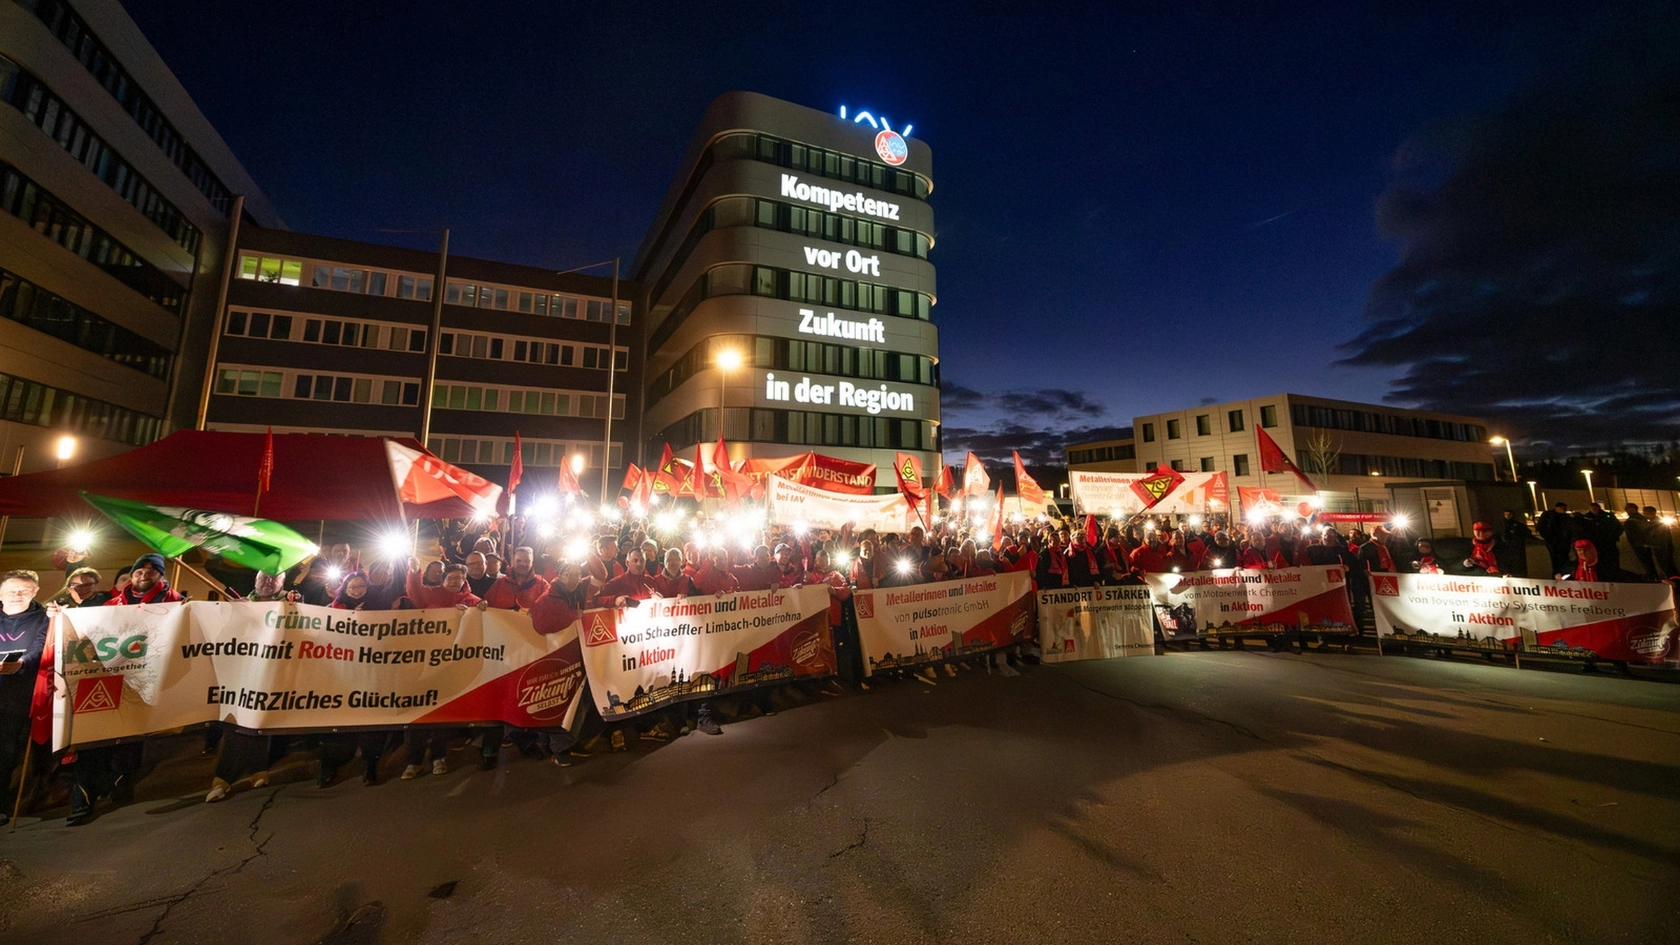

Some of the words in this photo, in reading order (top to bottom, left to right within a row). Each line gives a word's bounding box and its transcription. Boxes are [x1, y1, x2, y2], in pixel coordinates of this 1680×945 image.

[781, 173, 900, 221] Kompetenz
[803, 246, 842, 269] vor
[845, 249, 880, 277] Ort
[798, 308, 885, 343] Zukunft
[766, 372, 790, 401] in
[794, 377, 834, 405] der
[839, 381, 914, 414] Region
[803, 466, 873, 487] WIDERSTAND
[1079, 474, 1131, 483] Metallerinnen
[776, 492, 788, 501] bei
[790, 495, 806, 503] IAV
[1179, 573, 1241, 587] Metallerinnen
[1242, 573, 1262, 584] und
[1264, 573, 1302, 584] Metaller
[886, 587, 948, 606] Metallerinnen
[949, 585, 964, 597] und
[965, 580, 997, 595] Metaller
[1041, 590, 1093, 605] STANDORT
[1096, 590, 1103, 601] D
[1105, 588, 1151, 601] STÄRKEN
[1184, 592, 1201, 600] vom
[1203, 588, 1257, 598] Motorenwerk
[1260, 588, 1298, 597] Chemnitz
[1513, 584, 1541, 598] und
[1544, 585, 1610, 601] Metaller
[714, 596, 738, 614] und
[739, 593, 786, 611] Metaller
[894, 614, 910, 623] von
[912, 602, 962, 622] pulsotronic
[963, 600, 990, 612] GmbH
[1220, 602, 1230, 613] in
[1231, 602, 1264, 612] Aktion
[1408, 596, 1429, 605] von
[1513, 600, 1567, 613] Systems
[1570, 603, 1626, 616] Freiberg
[264, 609, 322, 630] Grüne
[326, 615, 452, 641] Leiterplatten,
[621, 632, 643, 645] von
[645, 623, 703, 641] Schaeffler
[705, 611, 802, 635] Limbach-Oberfrohna
[1452, 611, 1465, 623] in
[1468, 613, 1514, 626] Aktion
[909, 627, 918, 640] in
[920, 624, 948, 639] Aktion
[64, 634, 148, 664] KSG
[181, 638, 259, 658] werden
[261, 640, 294, 659] mit
[298, 640, 355, 662] Roten
[358, 646, 426, 664] Herzen
[429, 643, 505, 666] geboren!
[622, 654, 636, 672] in
[639, 647, 676, 667] Aktion
[62, 666, 99, 677] marter
[101, 662, 148, 674] together
[207, 685, 236, 705] Ein
[238, 687, 343, 711] hERZliches
[348, 689, 438, 708] Glückauf!
